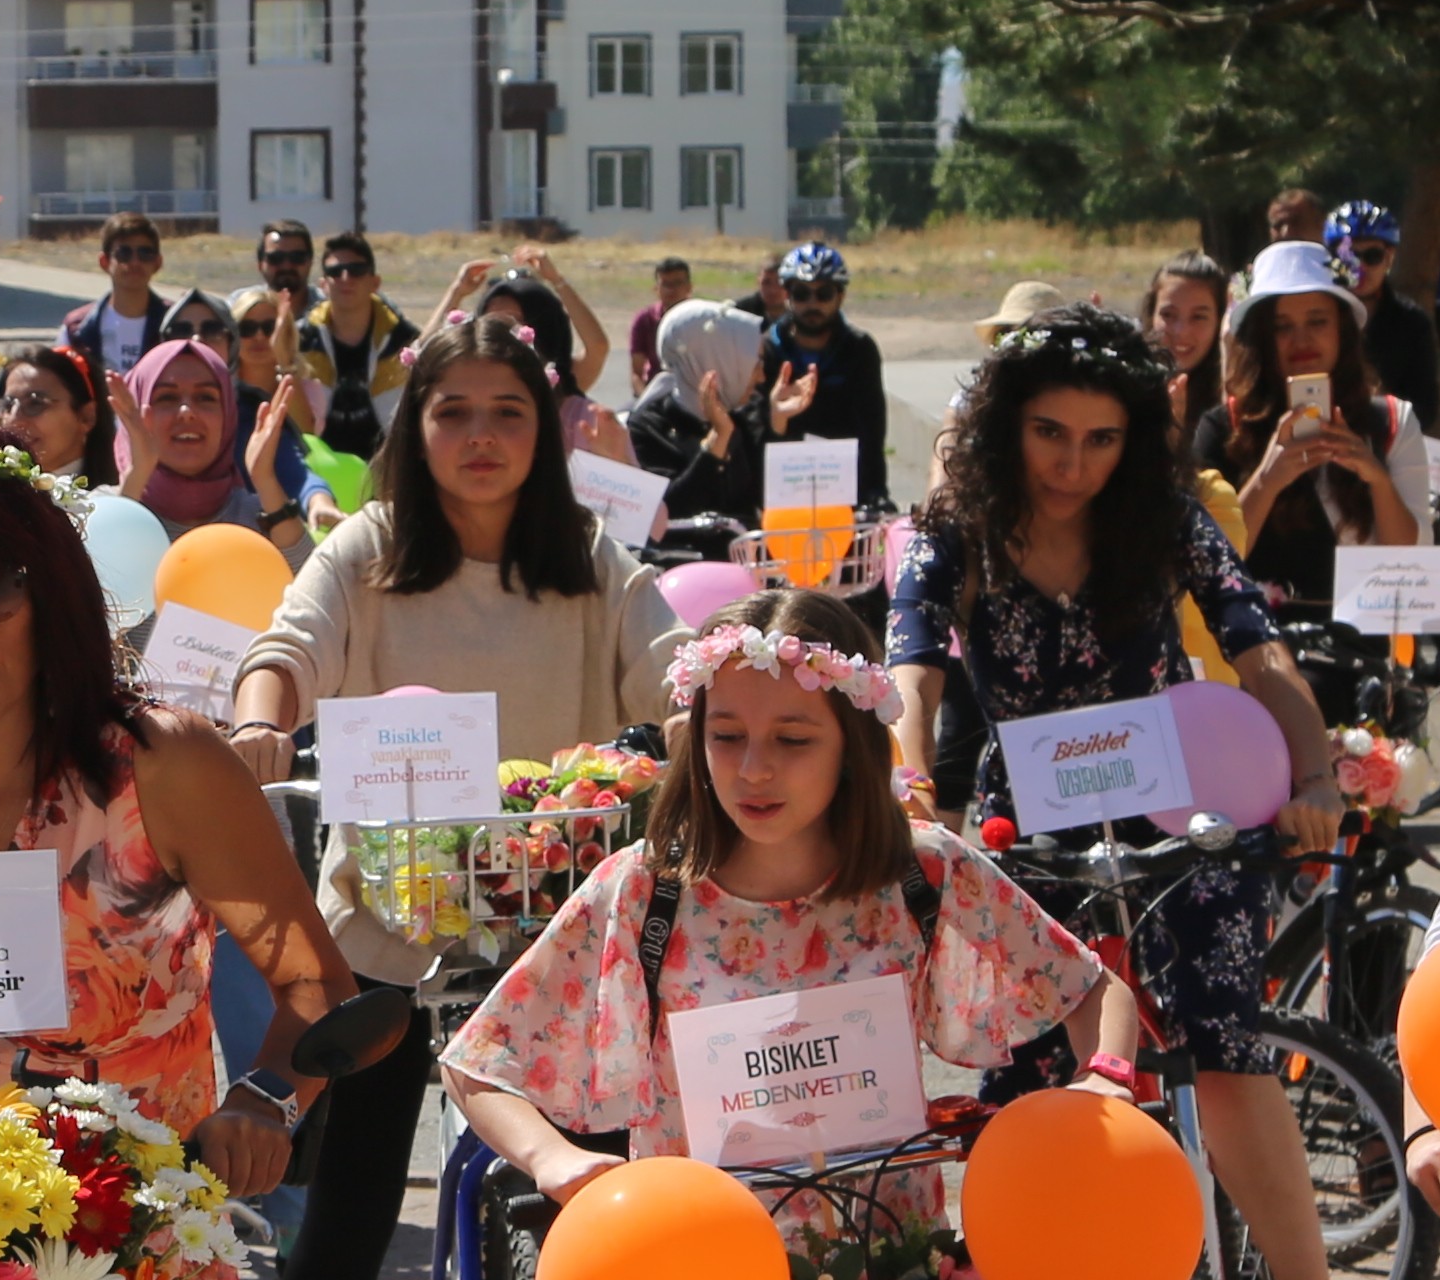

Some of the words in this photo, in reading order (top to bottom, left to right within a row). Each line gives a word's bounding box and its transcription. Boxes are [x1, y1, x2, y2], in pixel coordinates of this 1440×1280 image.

[379, 728, 442, 745] Bisiklet
[1052, 729, 1131, 762] Bisiklet
[744, 1035, 840, 1078] BİSİKLET
